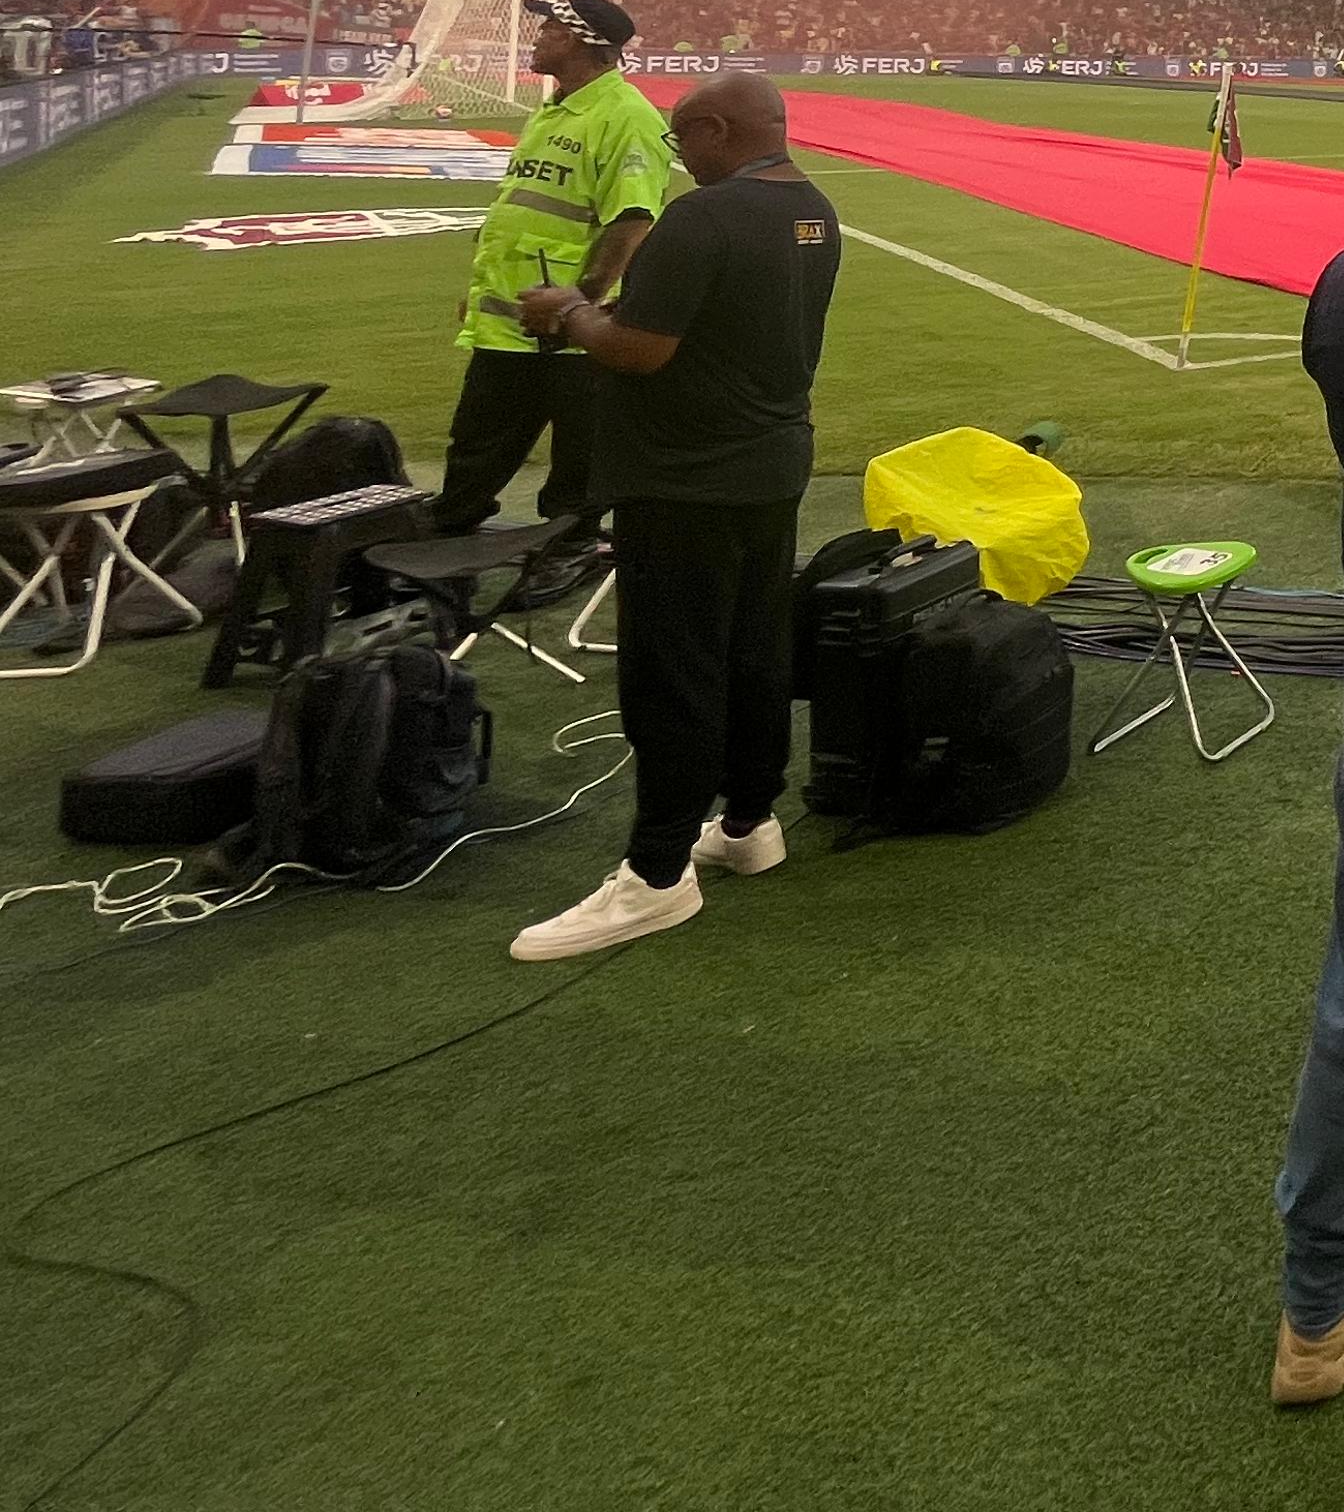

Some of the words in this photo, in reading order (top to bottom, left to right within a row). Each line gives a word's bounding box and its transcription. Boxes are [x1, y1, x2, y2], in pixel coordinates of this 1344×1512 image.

[646, 55, 720, 74] FERJ
[861, 57, 926, 74] FERJ
[547, 135, 582, 154] 1490
